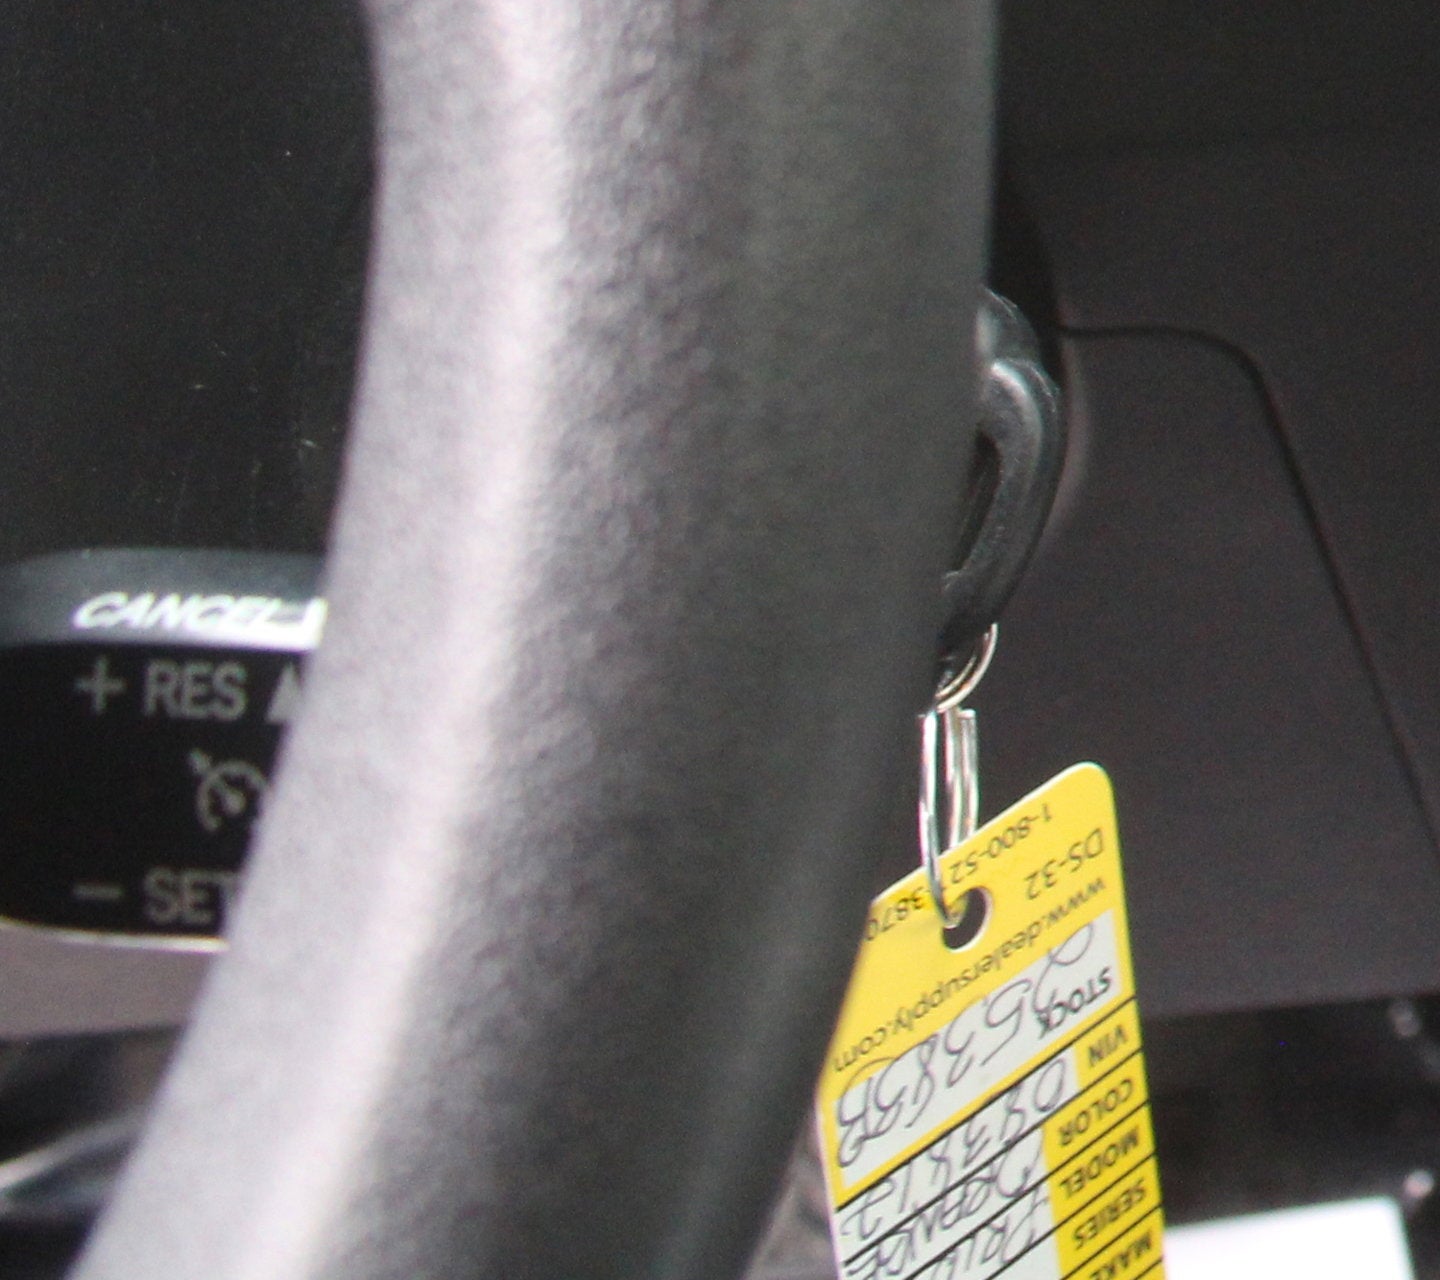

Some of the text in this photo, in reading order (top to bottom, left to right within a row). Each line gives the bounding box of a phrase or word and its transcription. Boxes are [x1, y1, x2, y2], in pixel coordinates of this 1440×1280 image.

[72, 590, 303, 640] CANCEL
[144, 657, 249, 723] RES
[863, 803, 1054, 943] 1-800-52-3870
[1024, 826, 1105, 902] DS-32
[833, 876, 1107, 1074] www.dealersupply.com
[1034, 965, 1112, 1040] STOCK
[1088, 1023, 1129, 1069] VIN
[1057, 1076, 1134, 1148] COLOR
[1058, 1125, 1141, 1199] MODEL
[1073, 1178, 1147, 1251] SERIES
